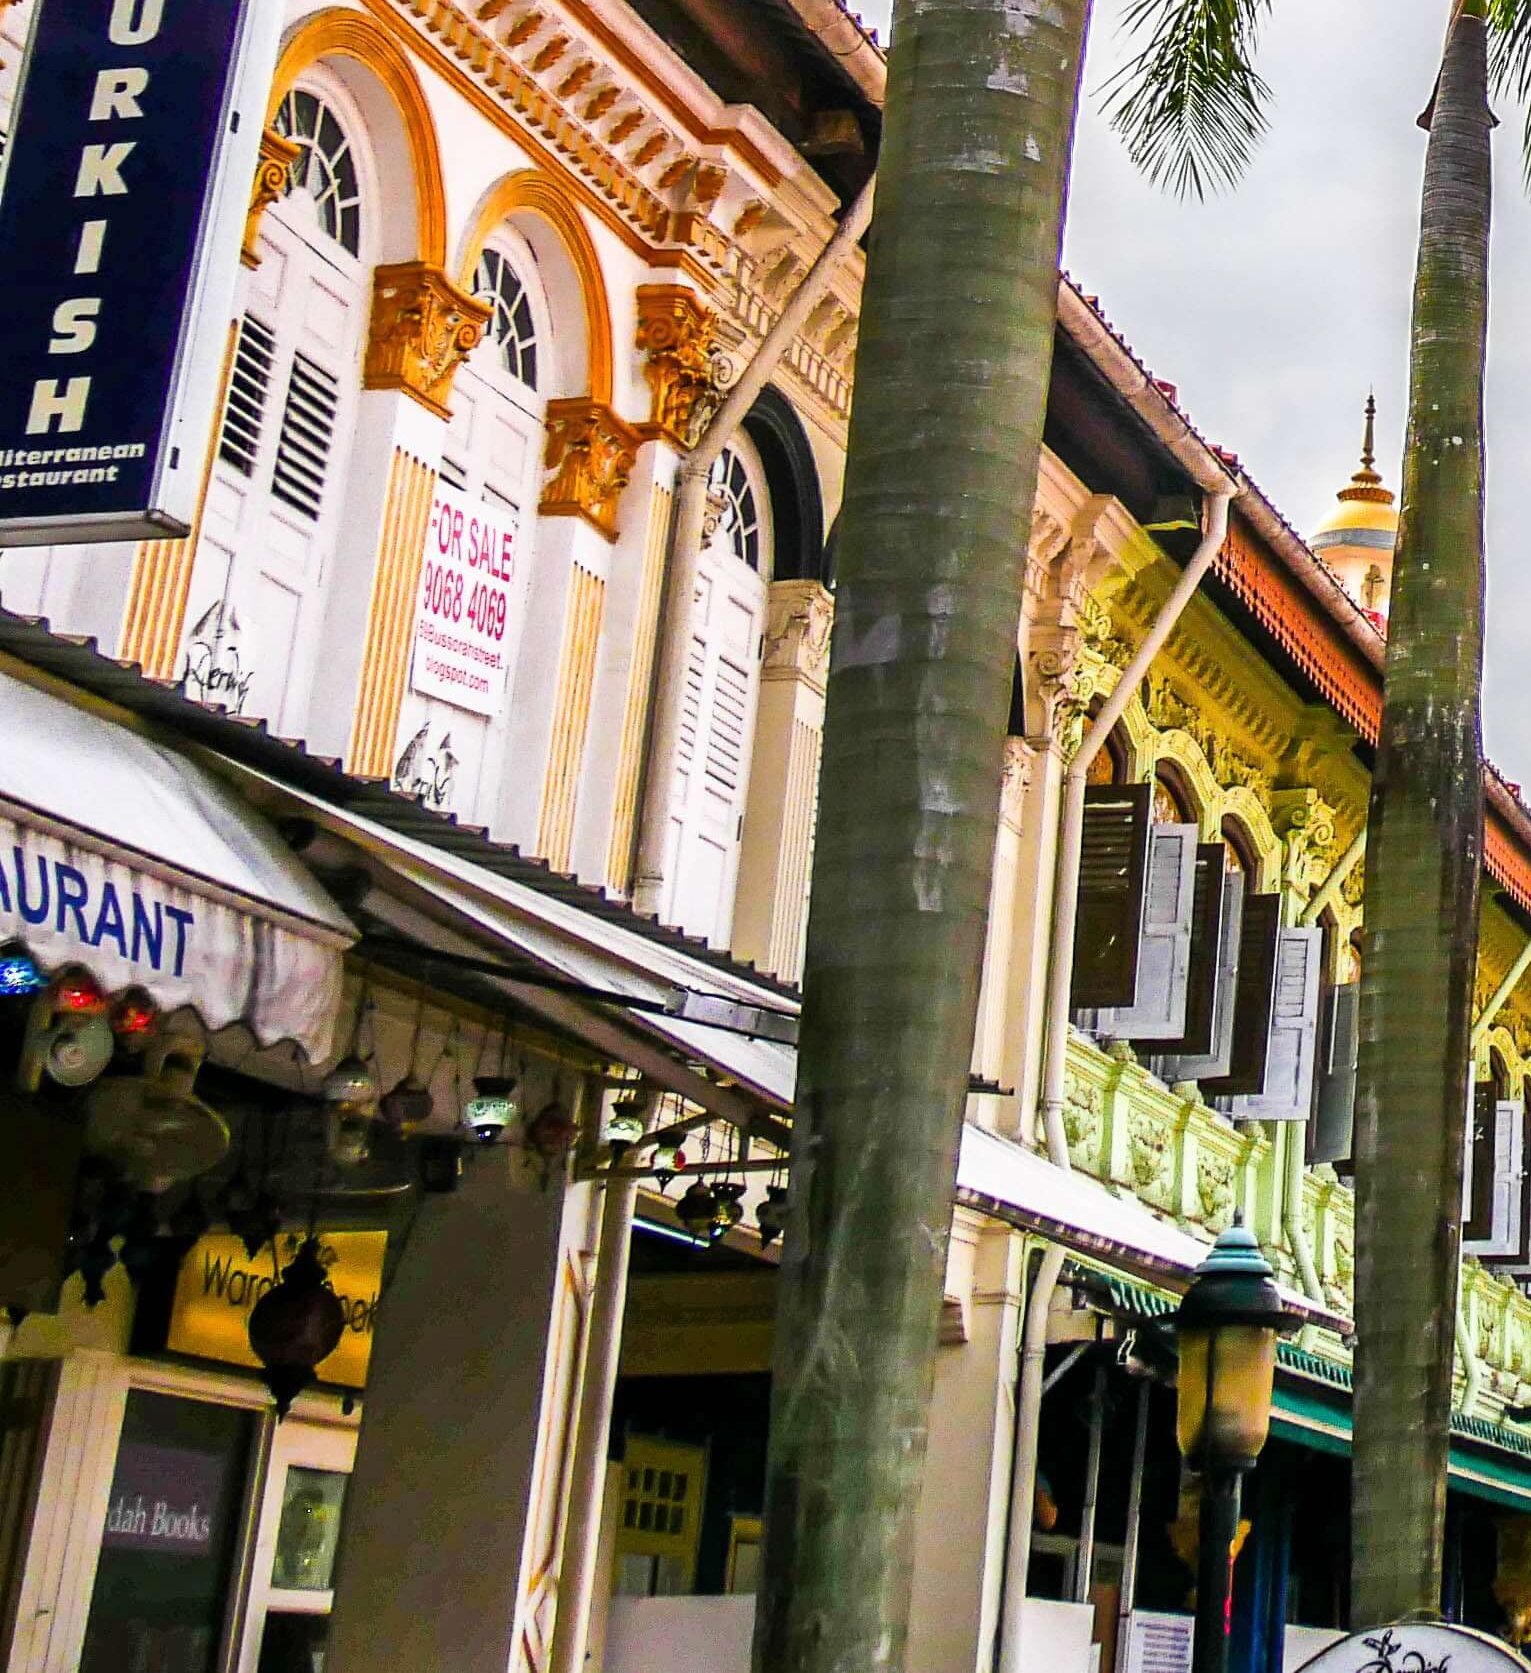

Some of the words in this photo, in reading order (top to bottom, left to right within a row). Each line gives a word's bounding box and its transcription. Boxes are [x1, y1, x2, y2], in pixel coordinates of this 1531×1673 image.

[0, 465, 119, 489] staurant
[468, 518, 513, 582] SALE
[423, 560, 464, 623] 9068
[467, 581, 507, 641] 4069
